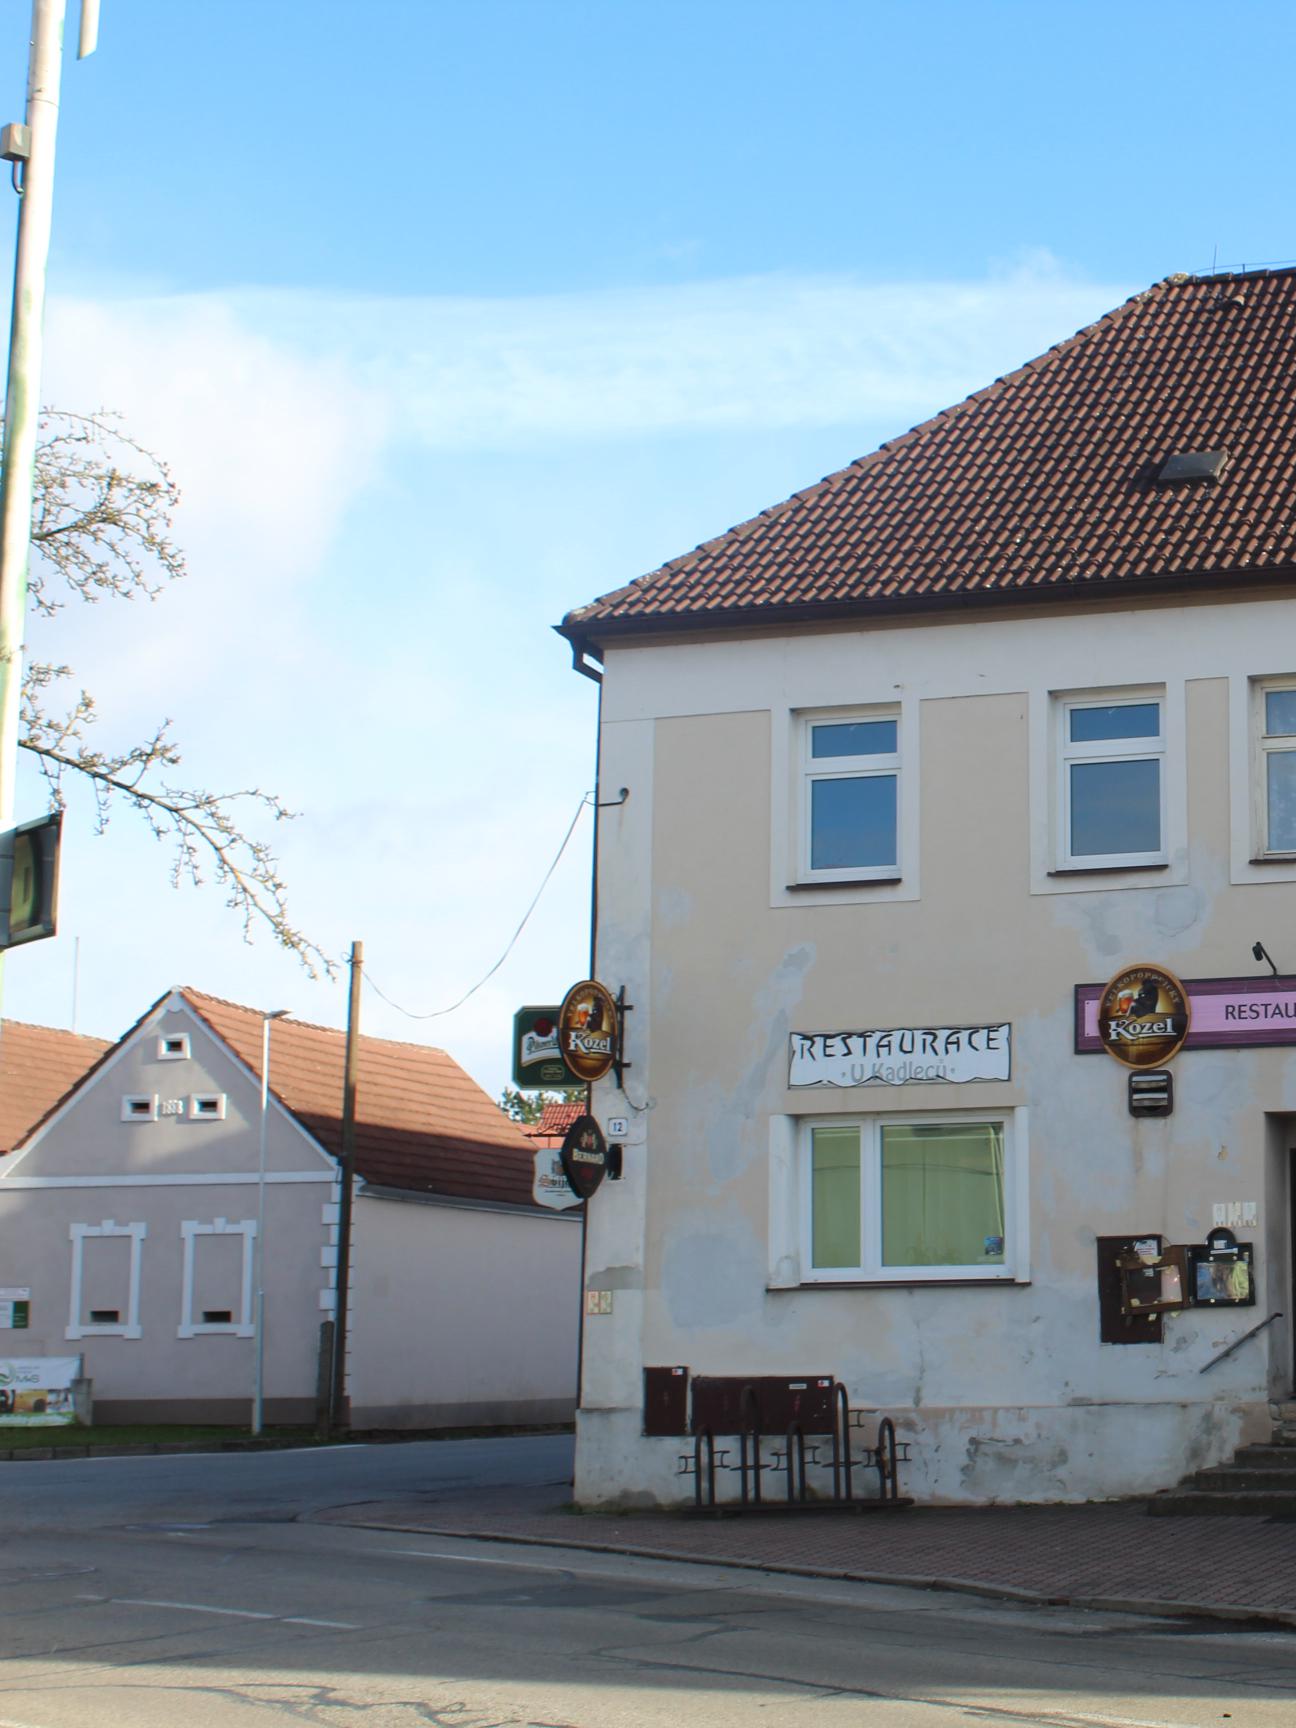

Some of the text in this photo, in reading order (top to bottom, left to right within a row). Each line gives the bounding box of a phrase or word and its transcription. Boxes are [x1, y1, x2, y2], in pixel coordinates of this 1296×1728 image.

[1108, 1017, 1178, 1041] Kozel
[568, 1031, 612, 1055] Kozel
[799, 1029, 1000, 1061] RESTAURACE
[850, 1063, 864, 1083] U
[612, 1121, 623, 1132] 12
